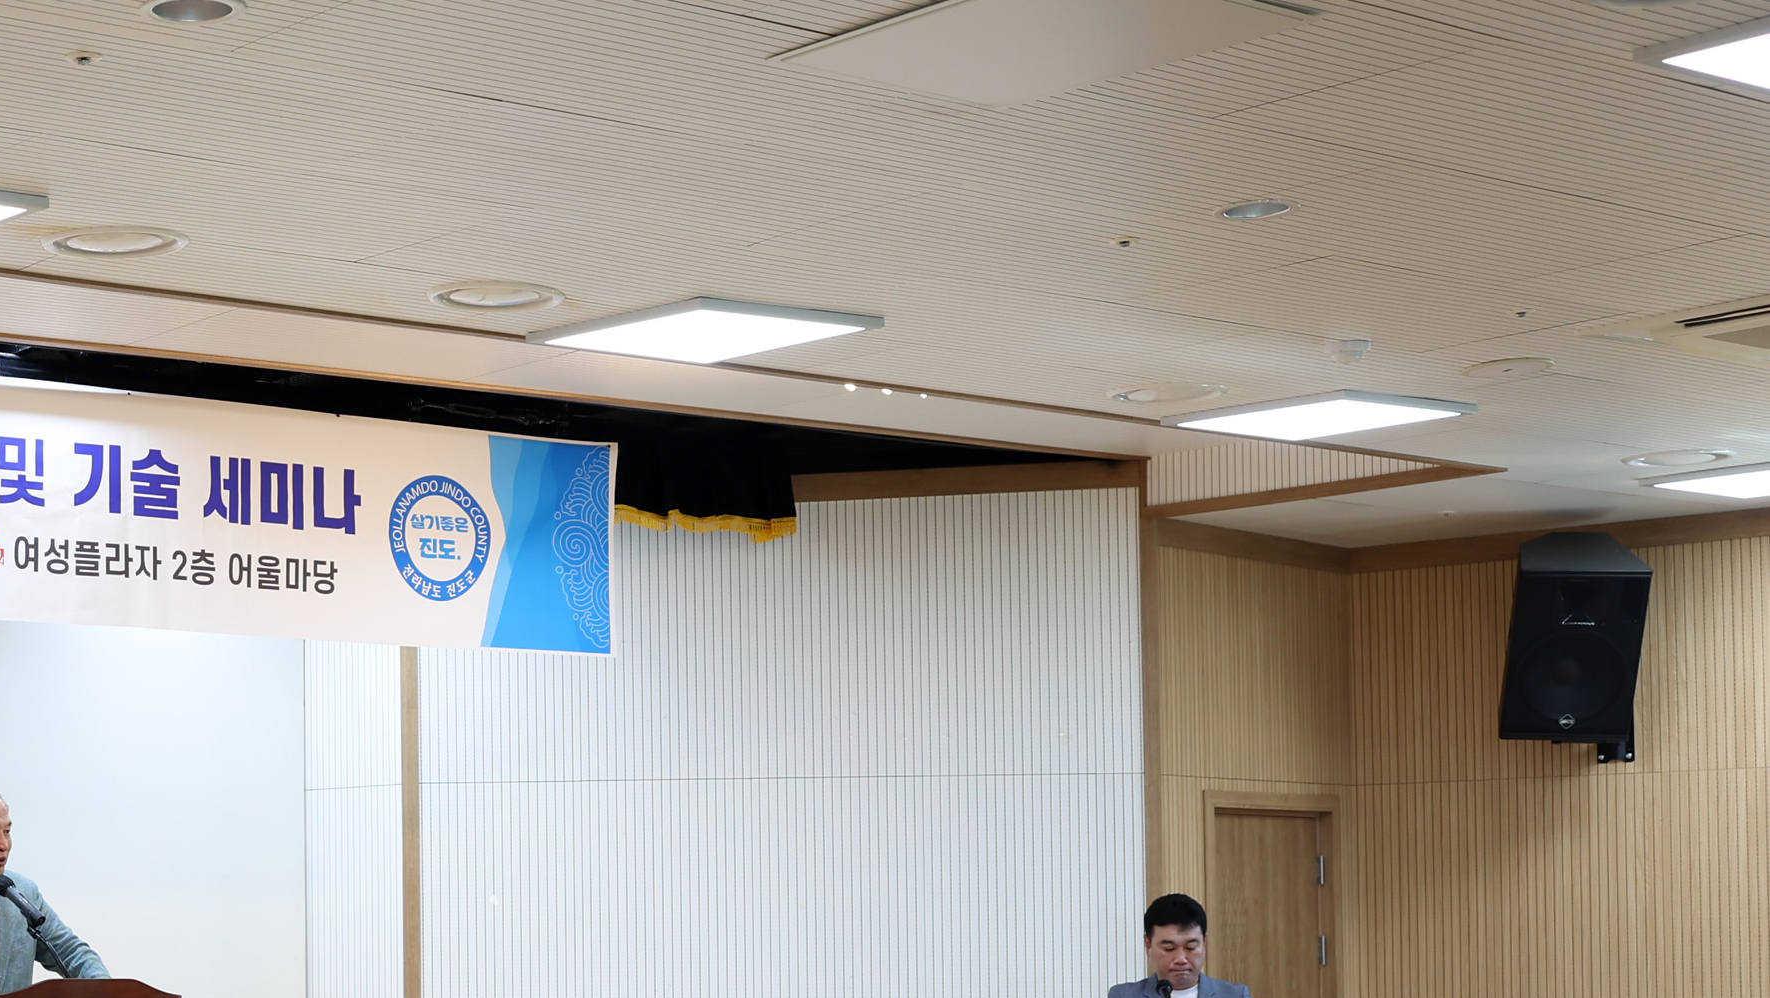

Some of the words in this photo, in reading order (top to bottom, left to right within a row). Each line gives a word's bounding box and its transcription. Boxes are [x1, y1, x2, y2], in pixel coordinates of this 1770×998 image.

[74, 443, 181, 521] 기술
[203, 456, 362, 536] 세미나
[392, 480, 438, 553] JEOLLANAMDO
[439, 481, 472, 508] JINDO
[470, 507, 488, 563] COUNTY
[410, 514, 469, 533] 살기좋은
[13, 535, 163, 581] 여성플라자
[171, 549, 216, 586] 2층
[228, 552, 339, 595] 어울마당
[419, 538, 462, 560] 진도.
[402, 563, 442, 598] 전라남도
[446, 570, 476, 597] 진도군
